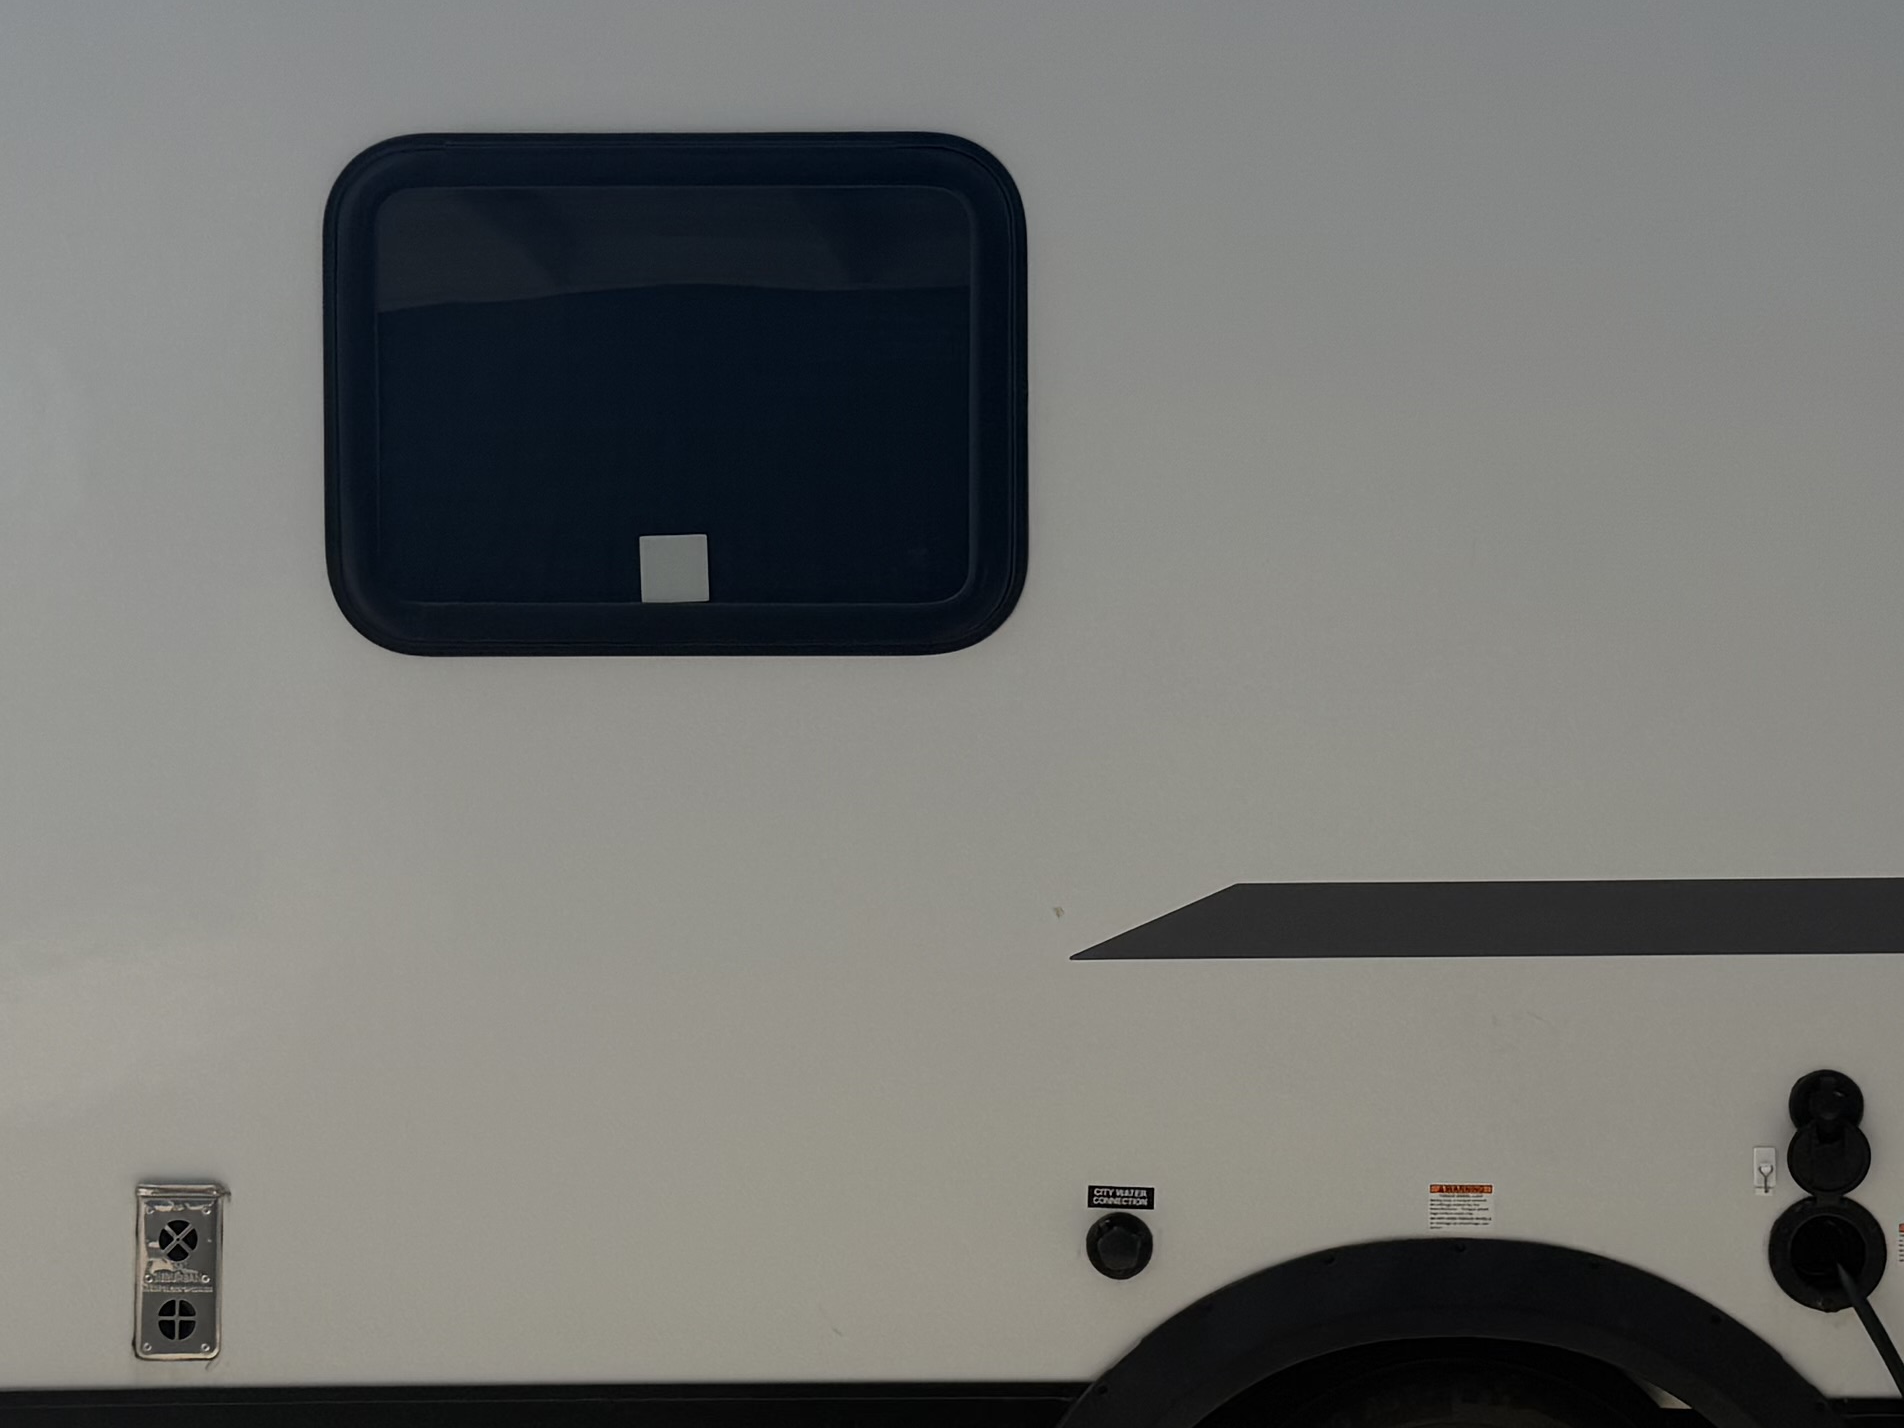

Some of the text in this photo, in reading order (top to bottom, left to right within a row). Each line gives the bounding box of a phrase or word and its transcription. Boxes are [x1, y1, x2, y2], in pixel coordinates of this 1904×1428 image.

[1094, 1188, 1147, 1197] CITY WATER
[1093, 1197, 1148, 1206] CONNECTION
